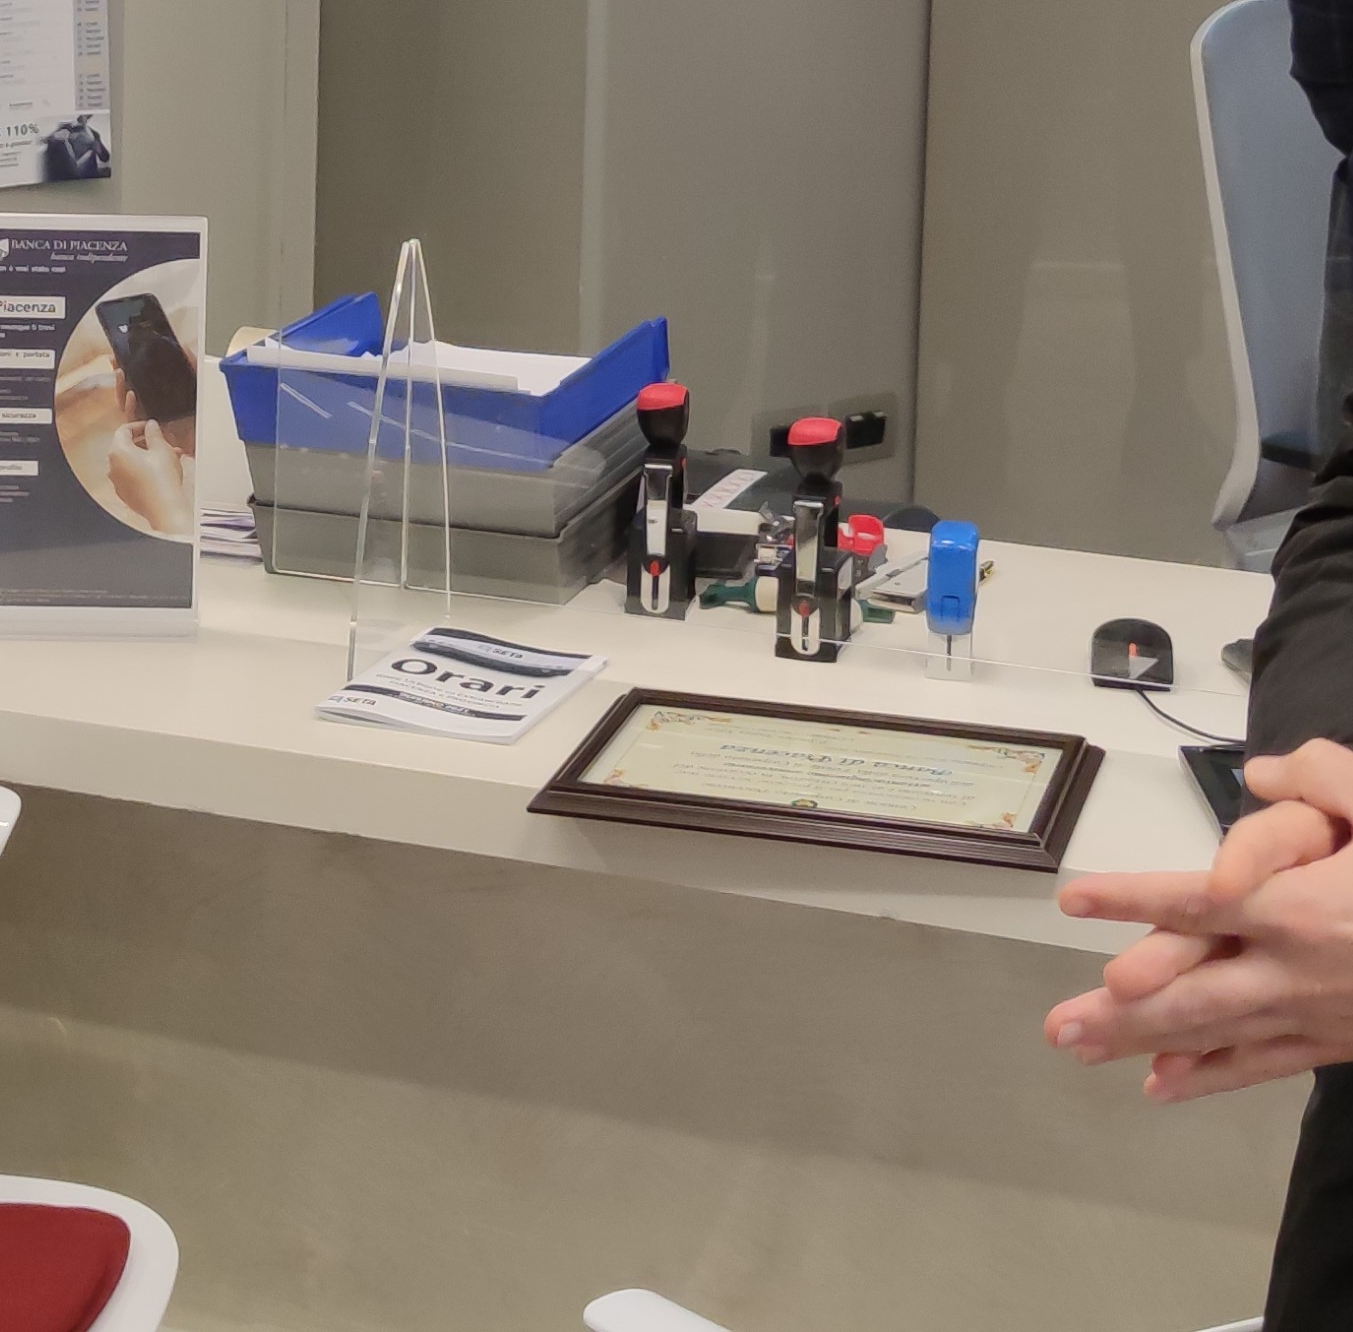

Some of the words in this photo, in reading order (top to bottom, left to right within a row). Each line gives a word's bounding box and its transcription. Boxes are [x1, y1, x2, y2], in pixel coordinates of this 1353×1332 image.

[6, 123, 40, 137] 110%
[12, 240, 50, 249] BANCA
[53, 240, 67, 250] DI
[70, 241, 128, 252] PIACENZA
[391, 659, 546, 699] Orari
[343, 695, 376, 707] SETA
